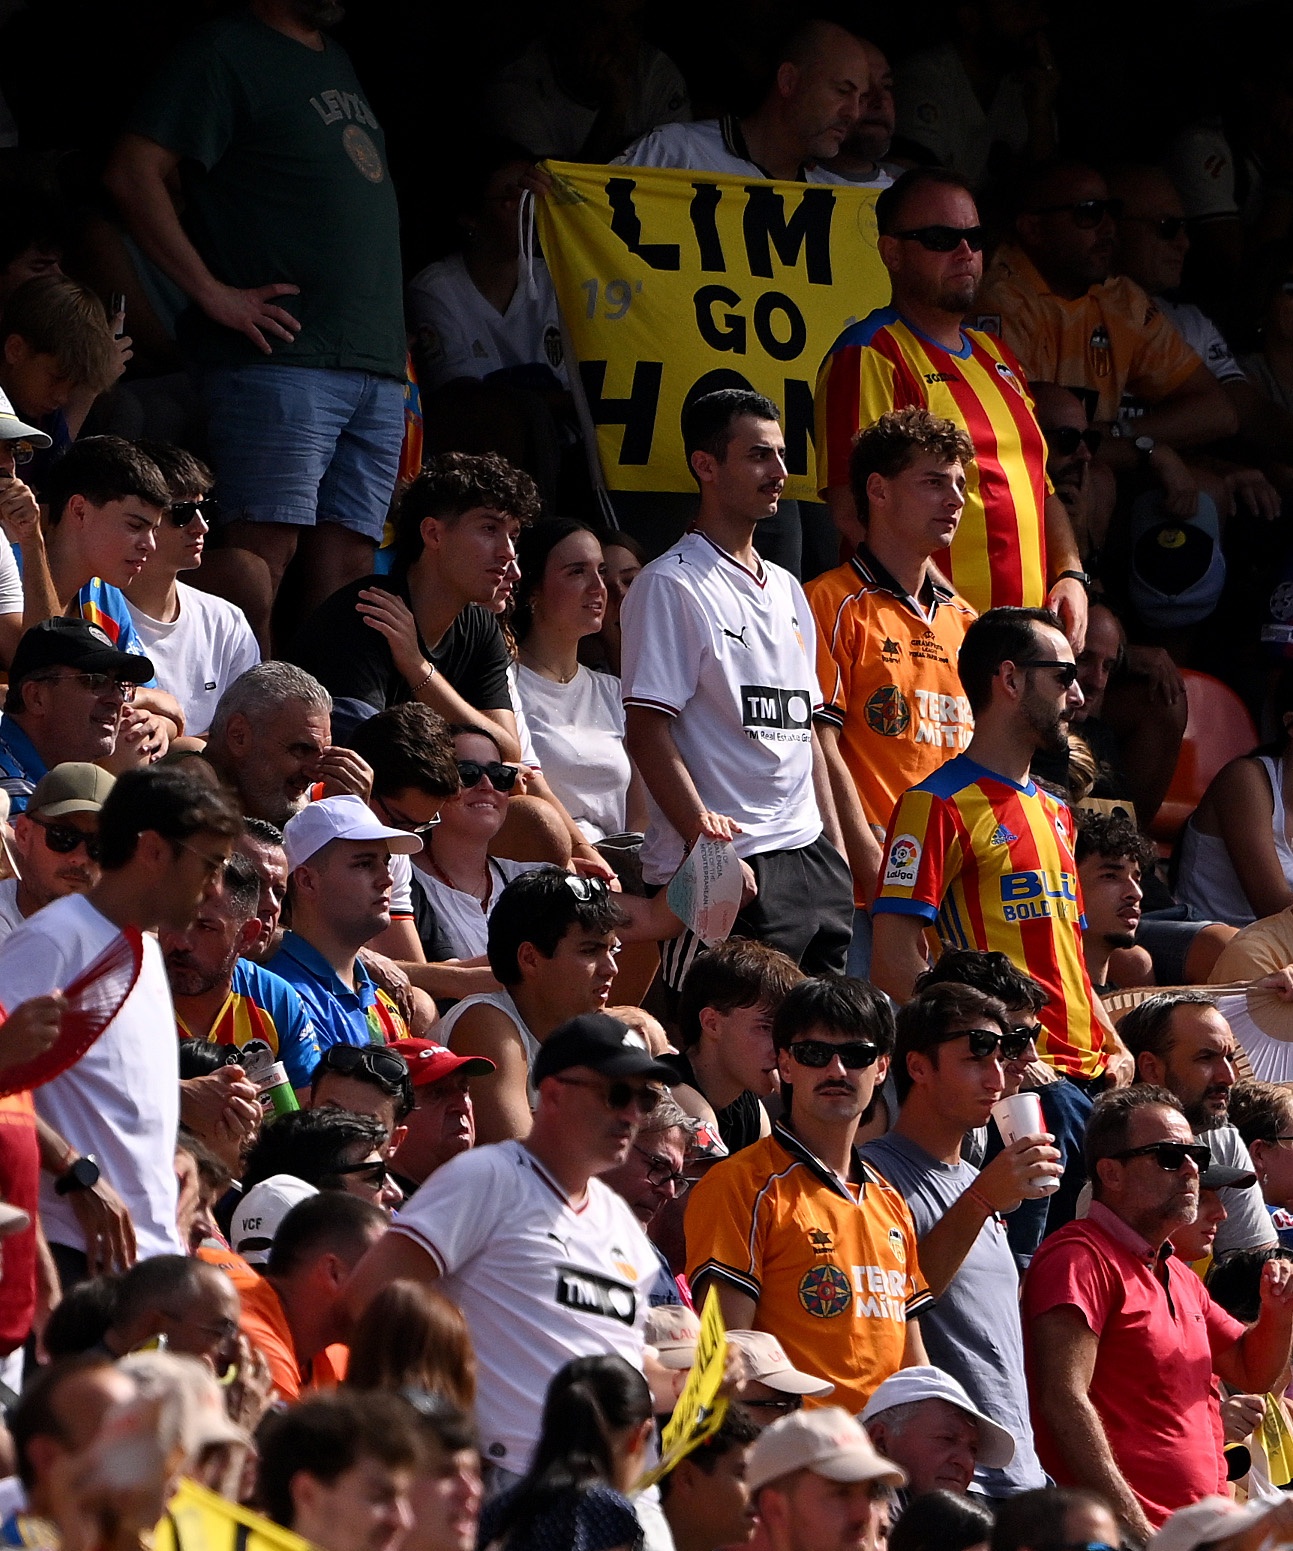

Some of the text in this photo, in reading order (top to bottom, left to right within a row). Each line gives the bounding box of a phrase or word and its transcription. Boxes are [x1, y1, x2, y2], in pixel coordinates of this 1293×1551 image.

[604, 178, 837, 286] LIM
[693, 284, 808, 362] GO
[748, 697, 778, 720] TM
[761, 730, 776, 740] Real
[1003, 902, 1052, 922] BOLD
[242, 1219, 262, 1230] VCF
